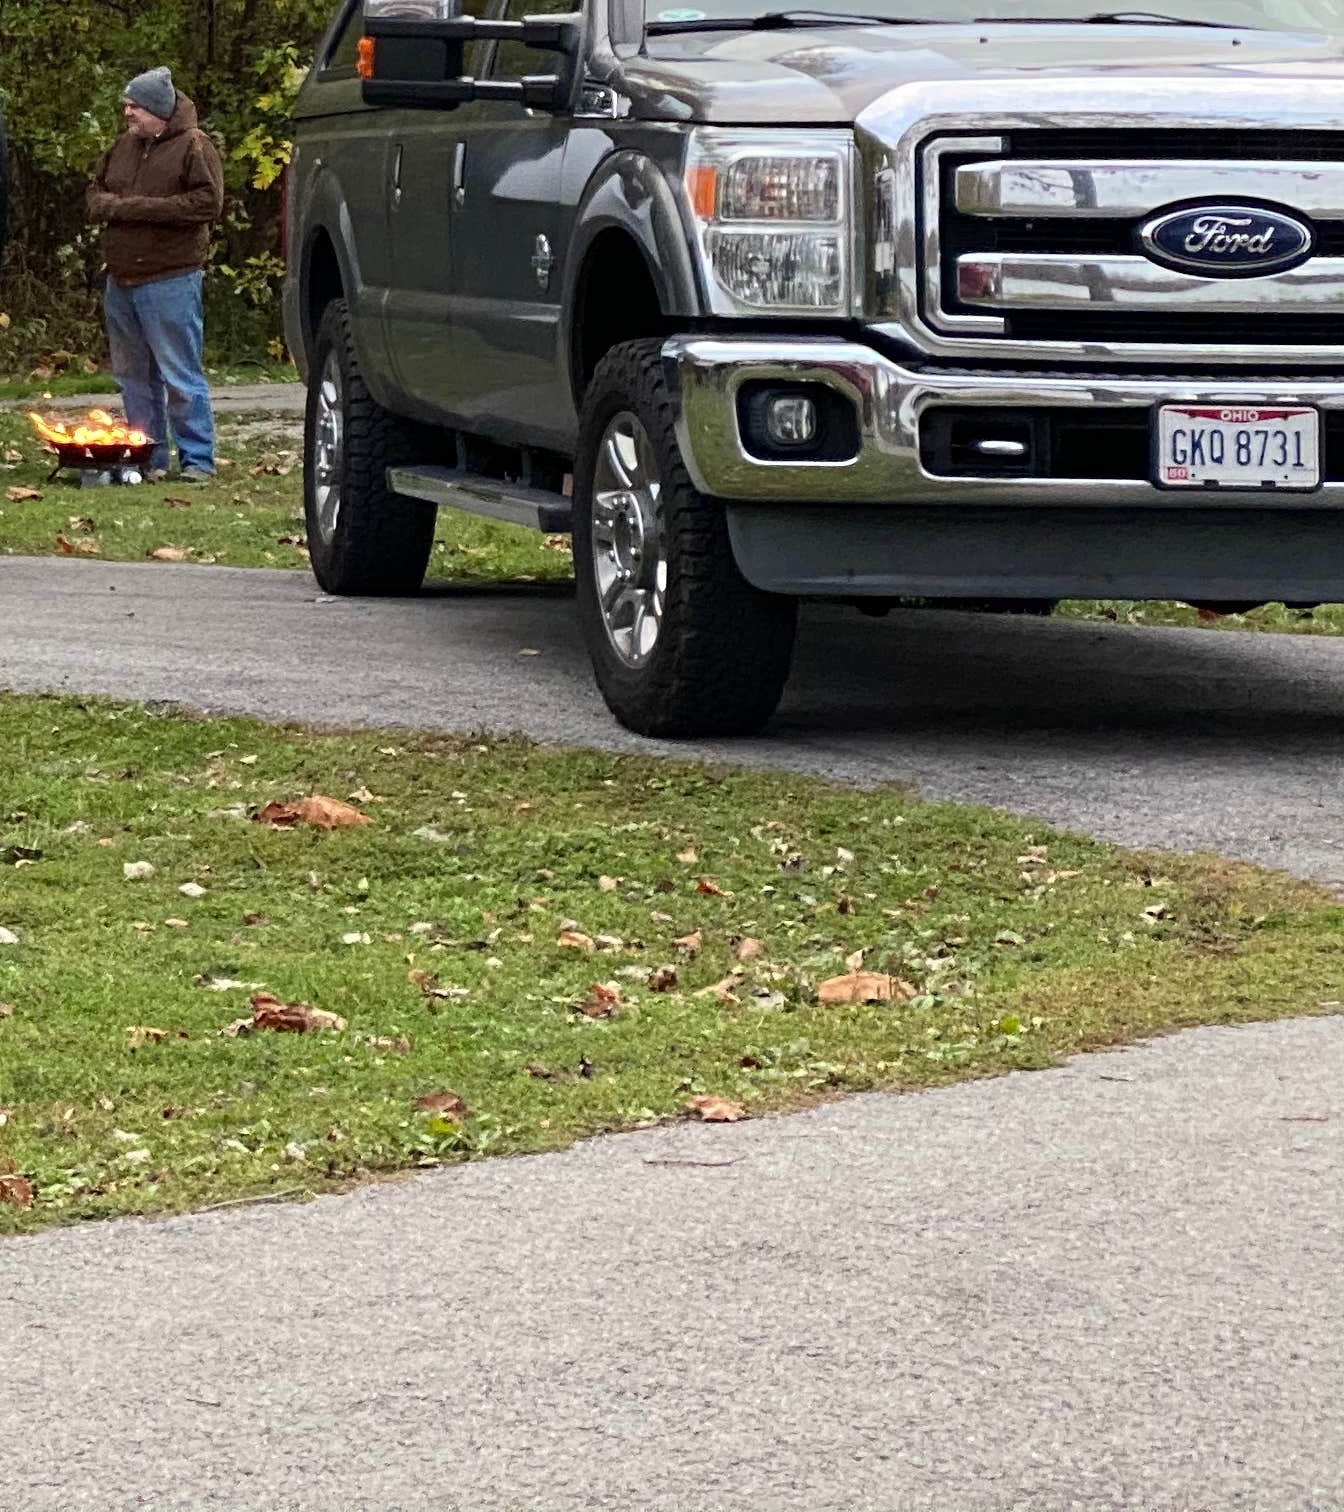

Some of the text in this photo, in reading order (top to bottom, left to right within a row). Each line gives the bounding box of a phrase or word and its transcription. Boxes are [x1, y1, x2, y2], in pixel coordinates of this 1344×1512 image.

[1184, 216, 1275, 253] Ford
[1220, 410, 1259, 422] OHIO
[1172, 429, 1304, 467] GKQ 8731
